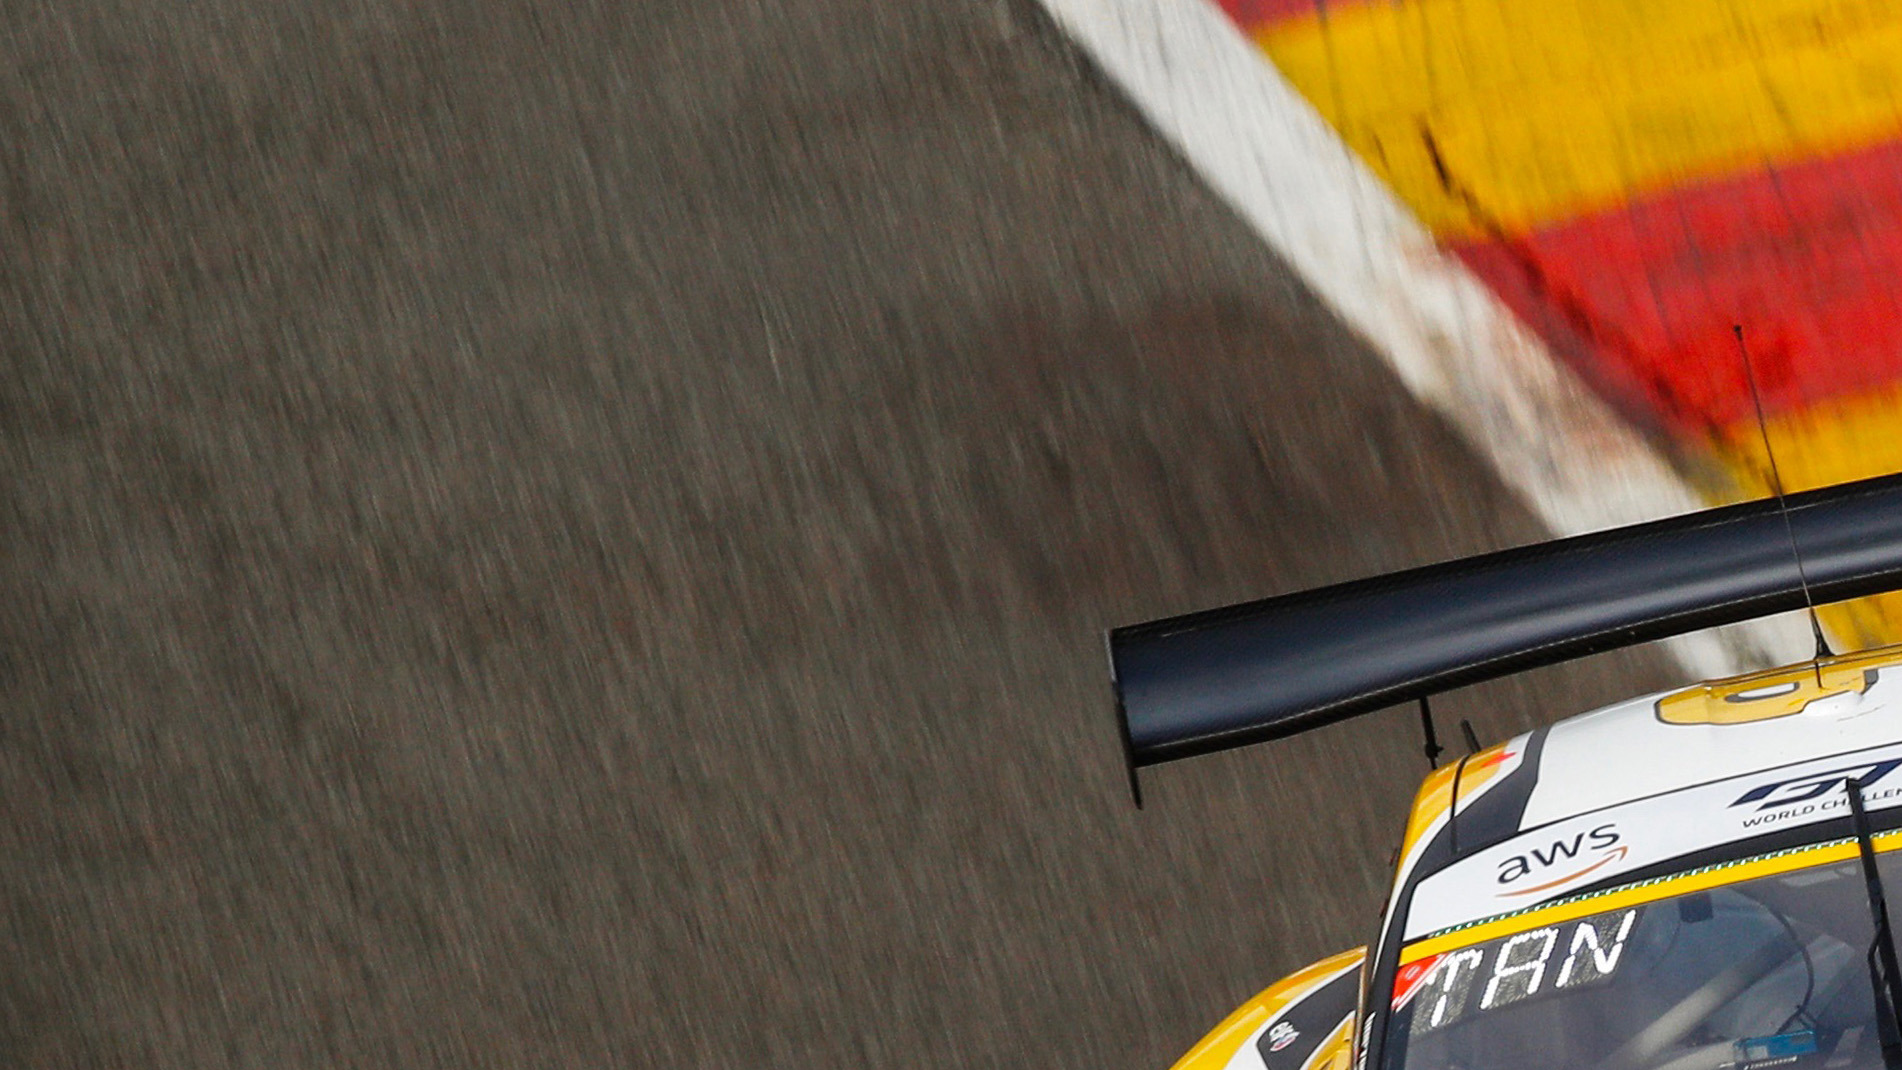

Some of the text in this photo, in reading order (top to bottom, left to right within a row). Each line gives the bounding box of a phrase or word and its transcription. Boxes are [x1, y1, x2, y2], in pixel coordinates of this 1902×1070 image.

[1742, 804, 1816, 829] WORLD
[1497, 823, 1620, 884] aws
[1425, 909, 1637, 1028] TAN
